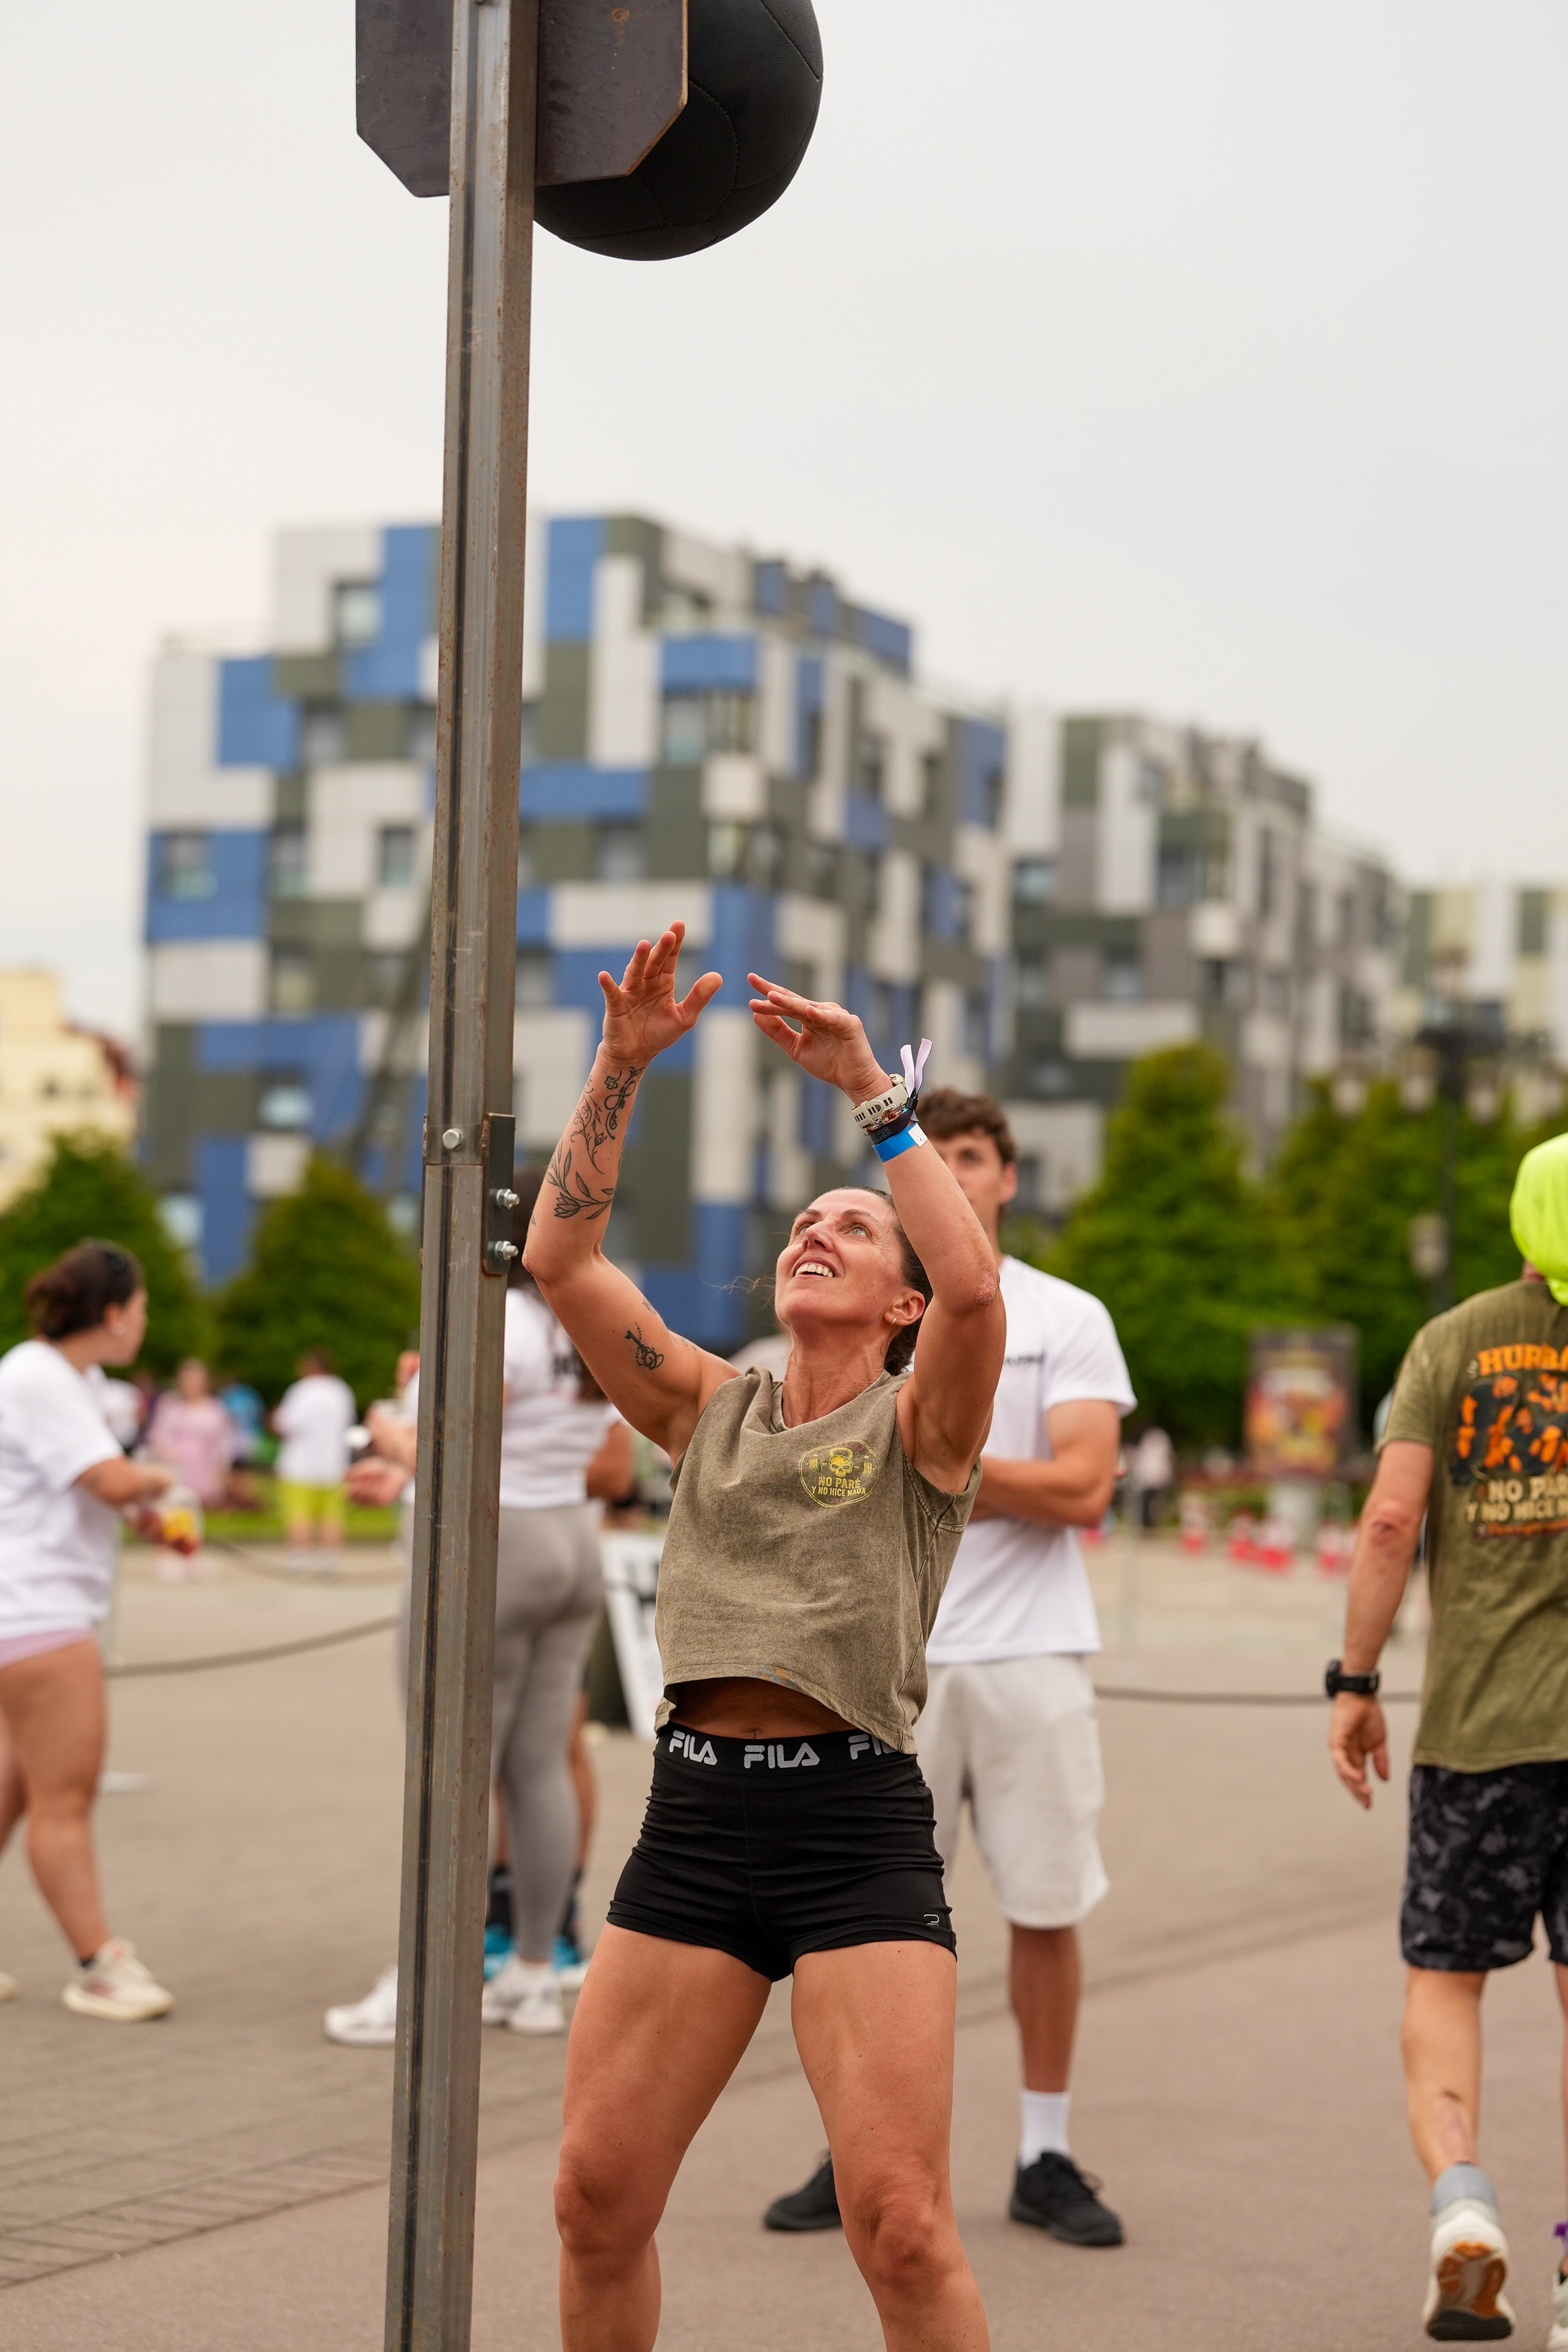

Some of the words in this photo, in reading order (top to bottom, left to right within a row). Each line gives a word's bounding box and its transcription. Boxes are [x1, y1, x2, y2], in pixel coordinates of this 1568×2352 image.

[812, 1485, 817, 1494] Y
[818, 1486, 828, 1495] NO
[829, 1487, 846, 1497] HICE
[847, 1487, 866, 1497] NADA
[818, 1476, 832, 1487] NO
[835, 1477, 861, 1489] PARÉ
[1487, 1478, 1523, 1503] NO
[669, 1729, 718, 1766] FILA
[744, 1742, 820, 1769] FILA
